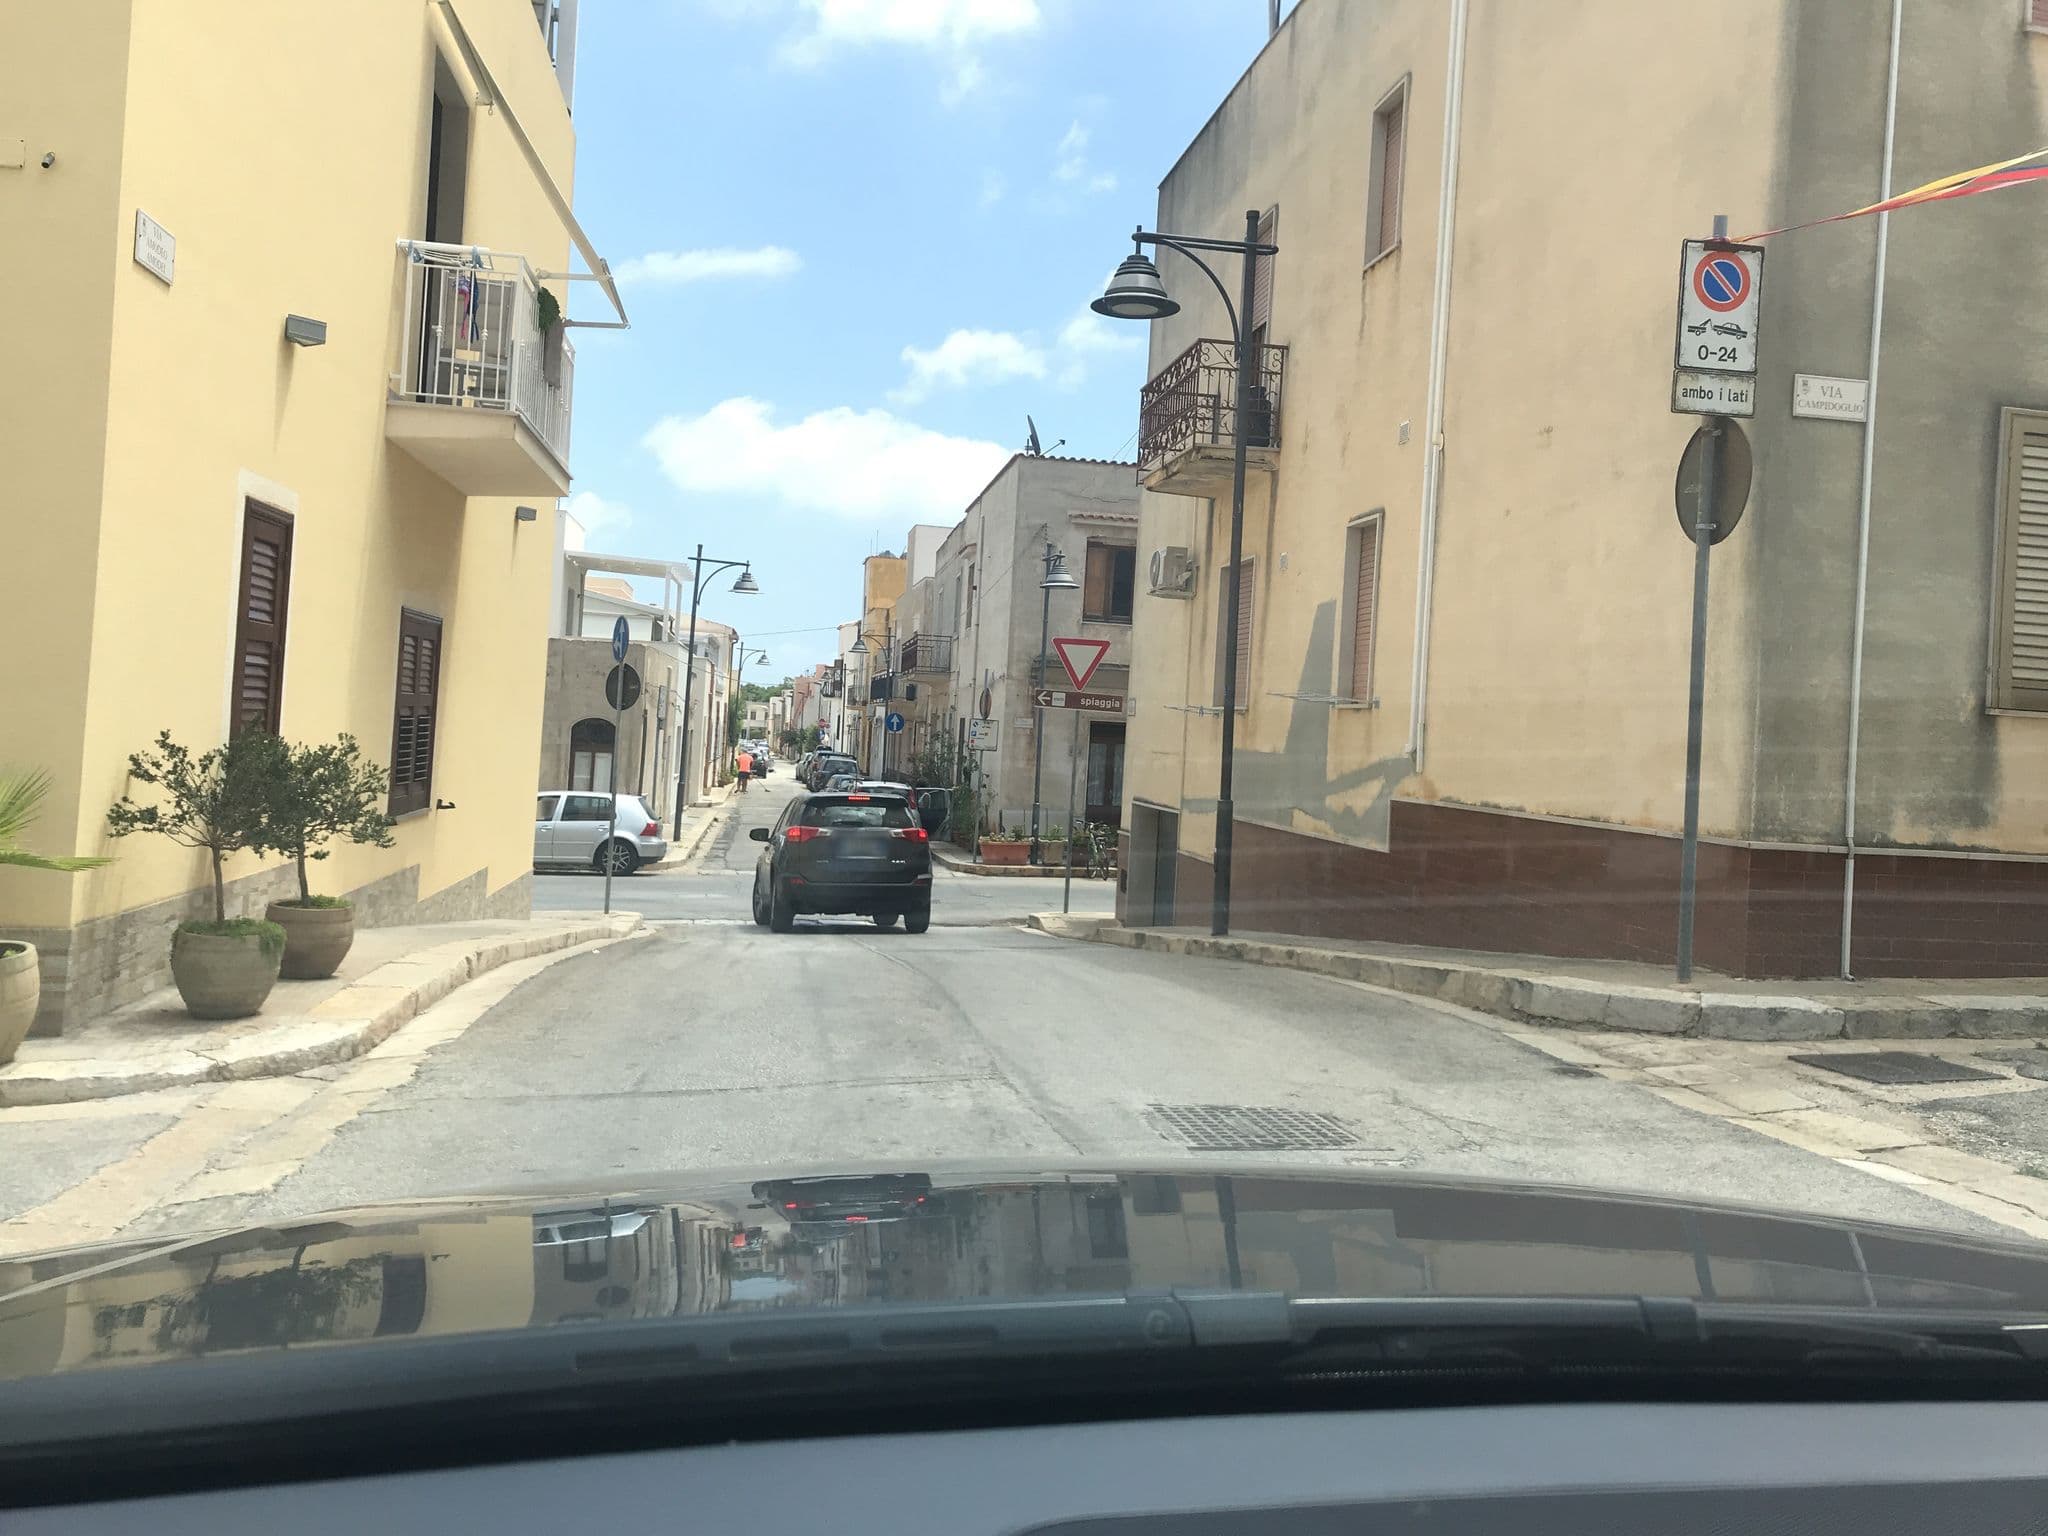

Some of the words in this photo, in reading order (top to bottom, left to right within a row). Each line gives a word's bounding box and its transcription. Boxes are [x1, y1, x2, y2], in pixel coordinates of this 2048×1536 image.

[1697, 345, 1738, 363] 0-24
[1682, 386, 1714, 401] ambo
[1719, 387, 1723, 401] i
[1728, 388, 1749, 403] lati
[1820, 385, 1843, 399] VIA
[1798, 399, 1864, 413] CAMPIDOGLIO
[1080, 697, 1121, 709] spiaggia
